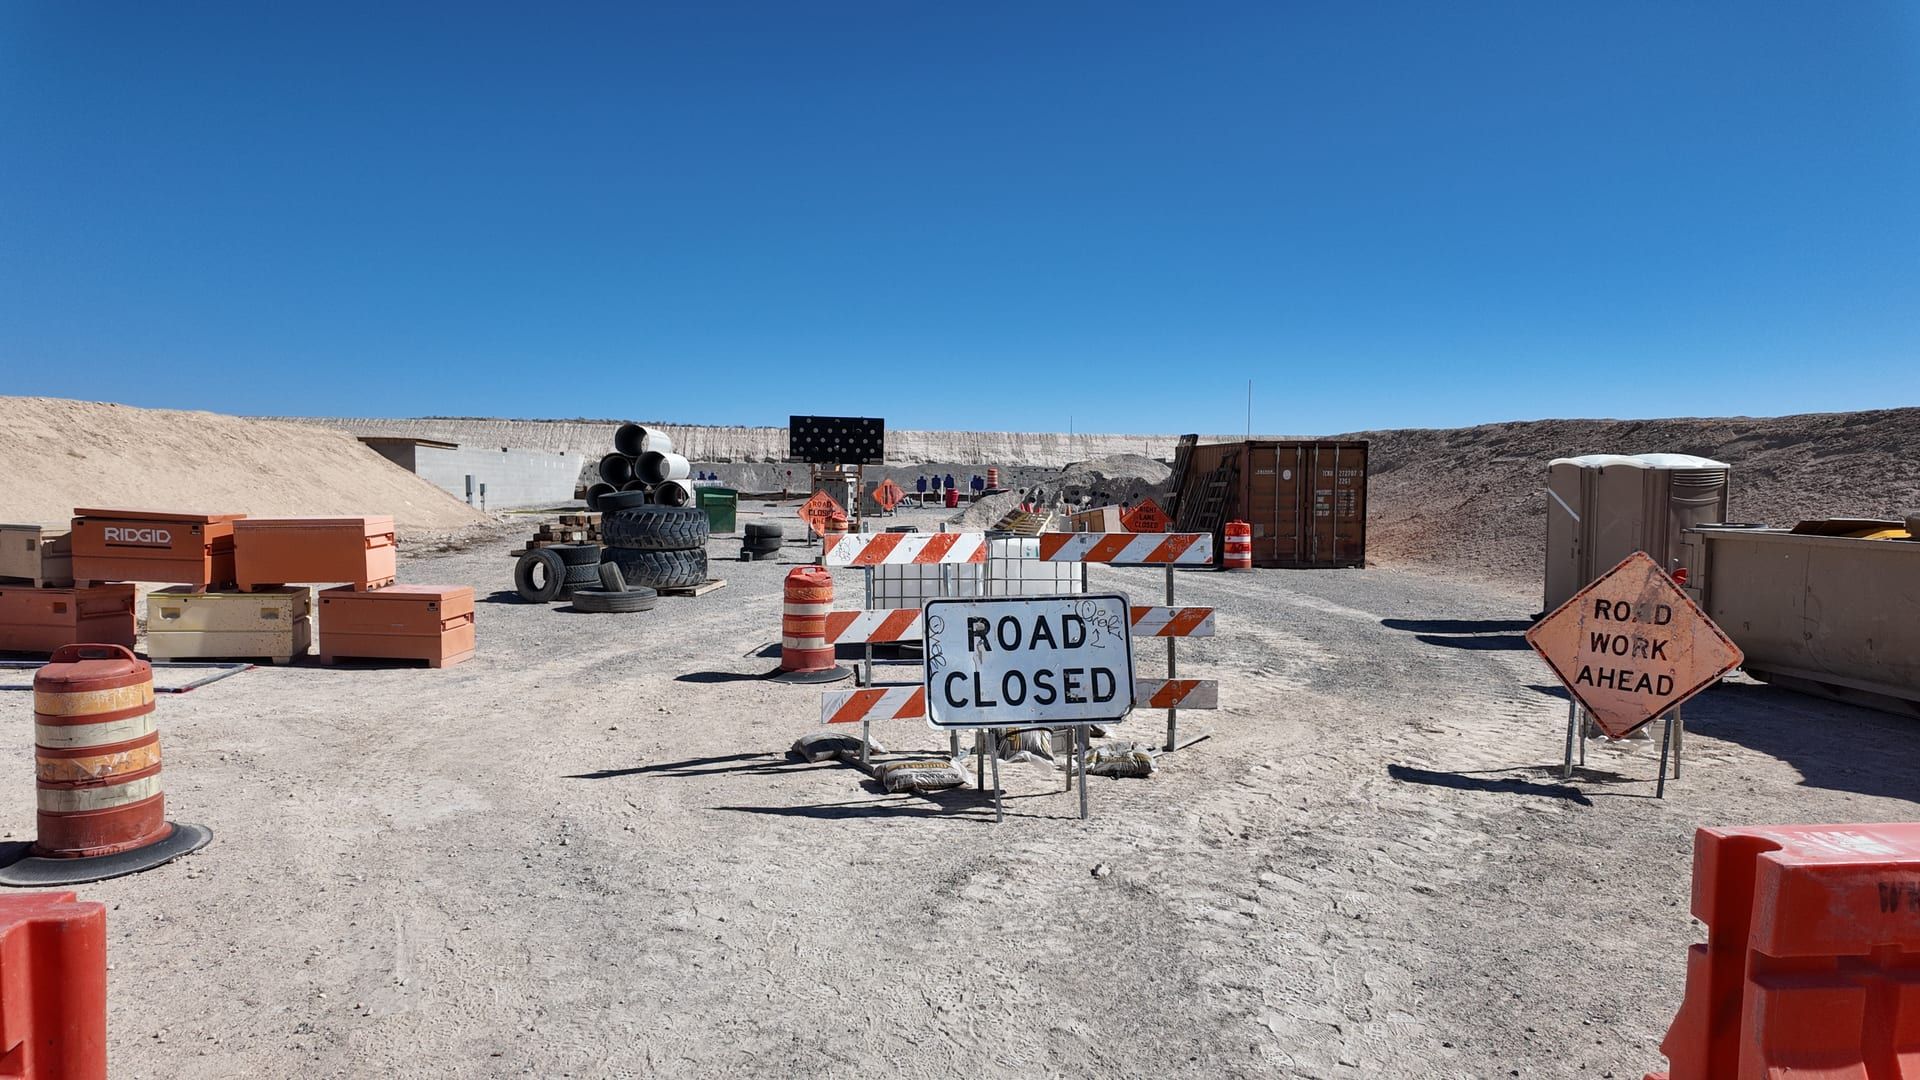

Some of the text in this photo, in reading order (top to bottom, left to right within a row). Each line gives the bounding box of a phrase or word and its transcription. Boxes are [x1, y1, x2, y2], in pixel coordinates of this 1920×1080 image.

[104, 527, 171, 543] RIDGID
[1134, 521, 1159, 529] CLOSED
[968, 614, 1087, 652] ROAD
[1591, 632, 1668, 661] WORK
[944, 667, 1116, 709] CLOSED
[1575, 665, 1674, 696] AHEAD
